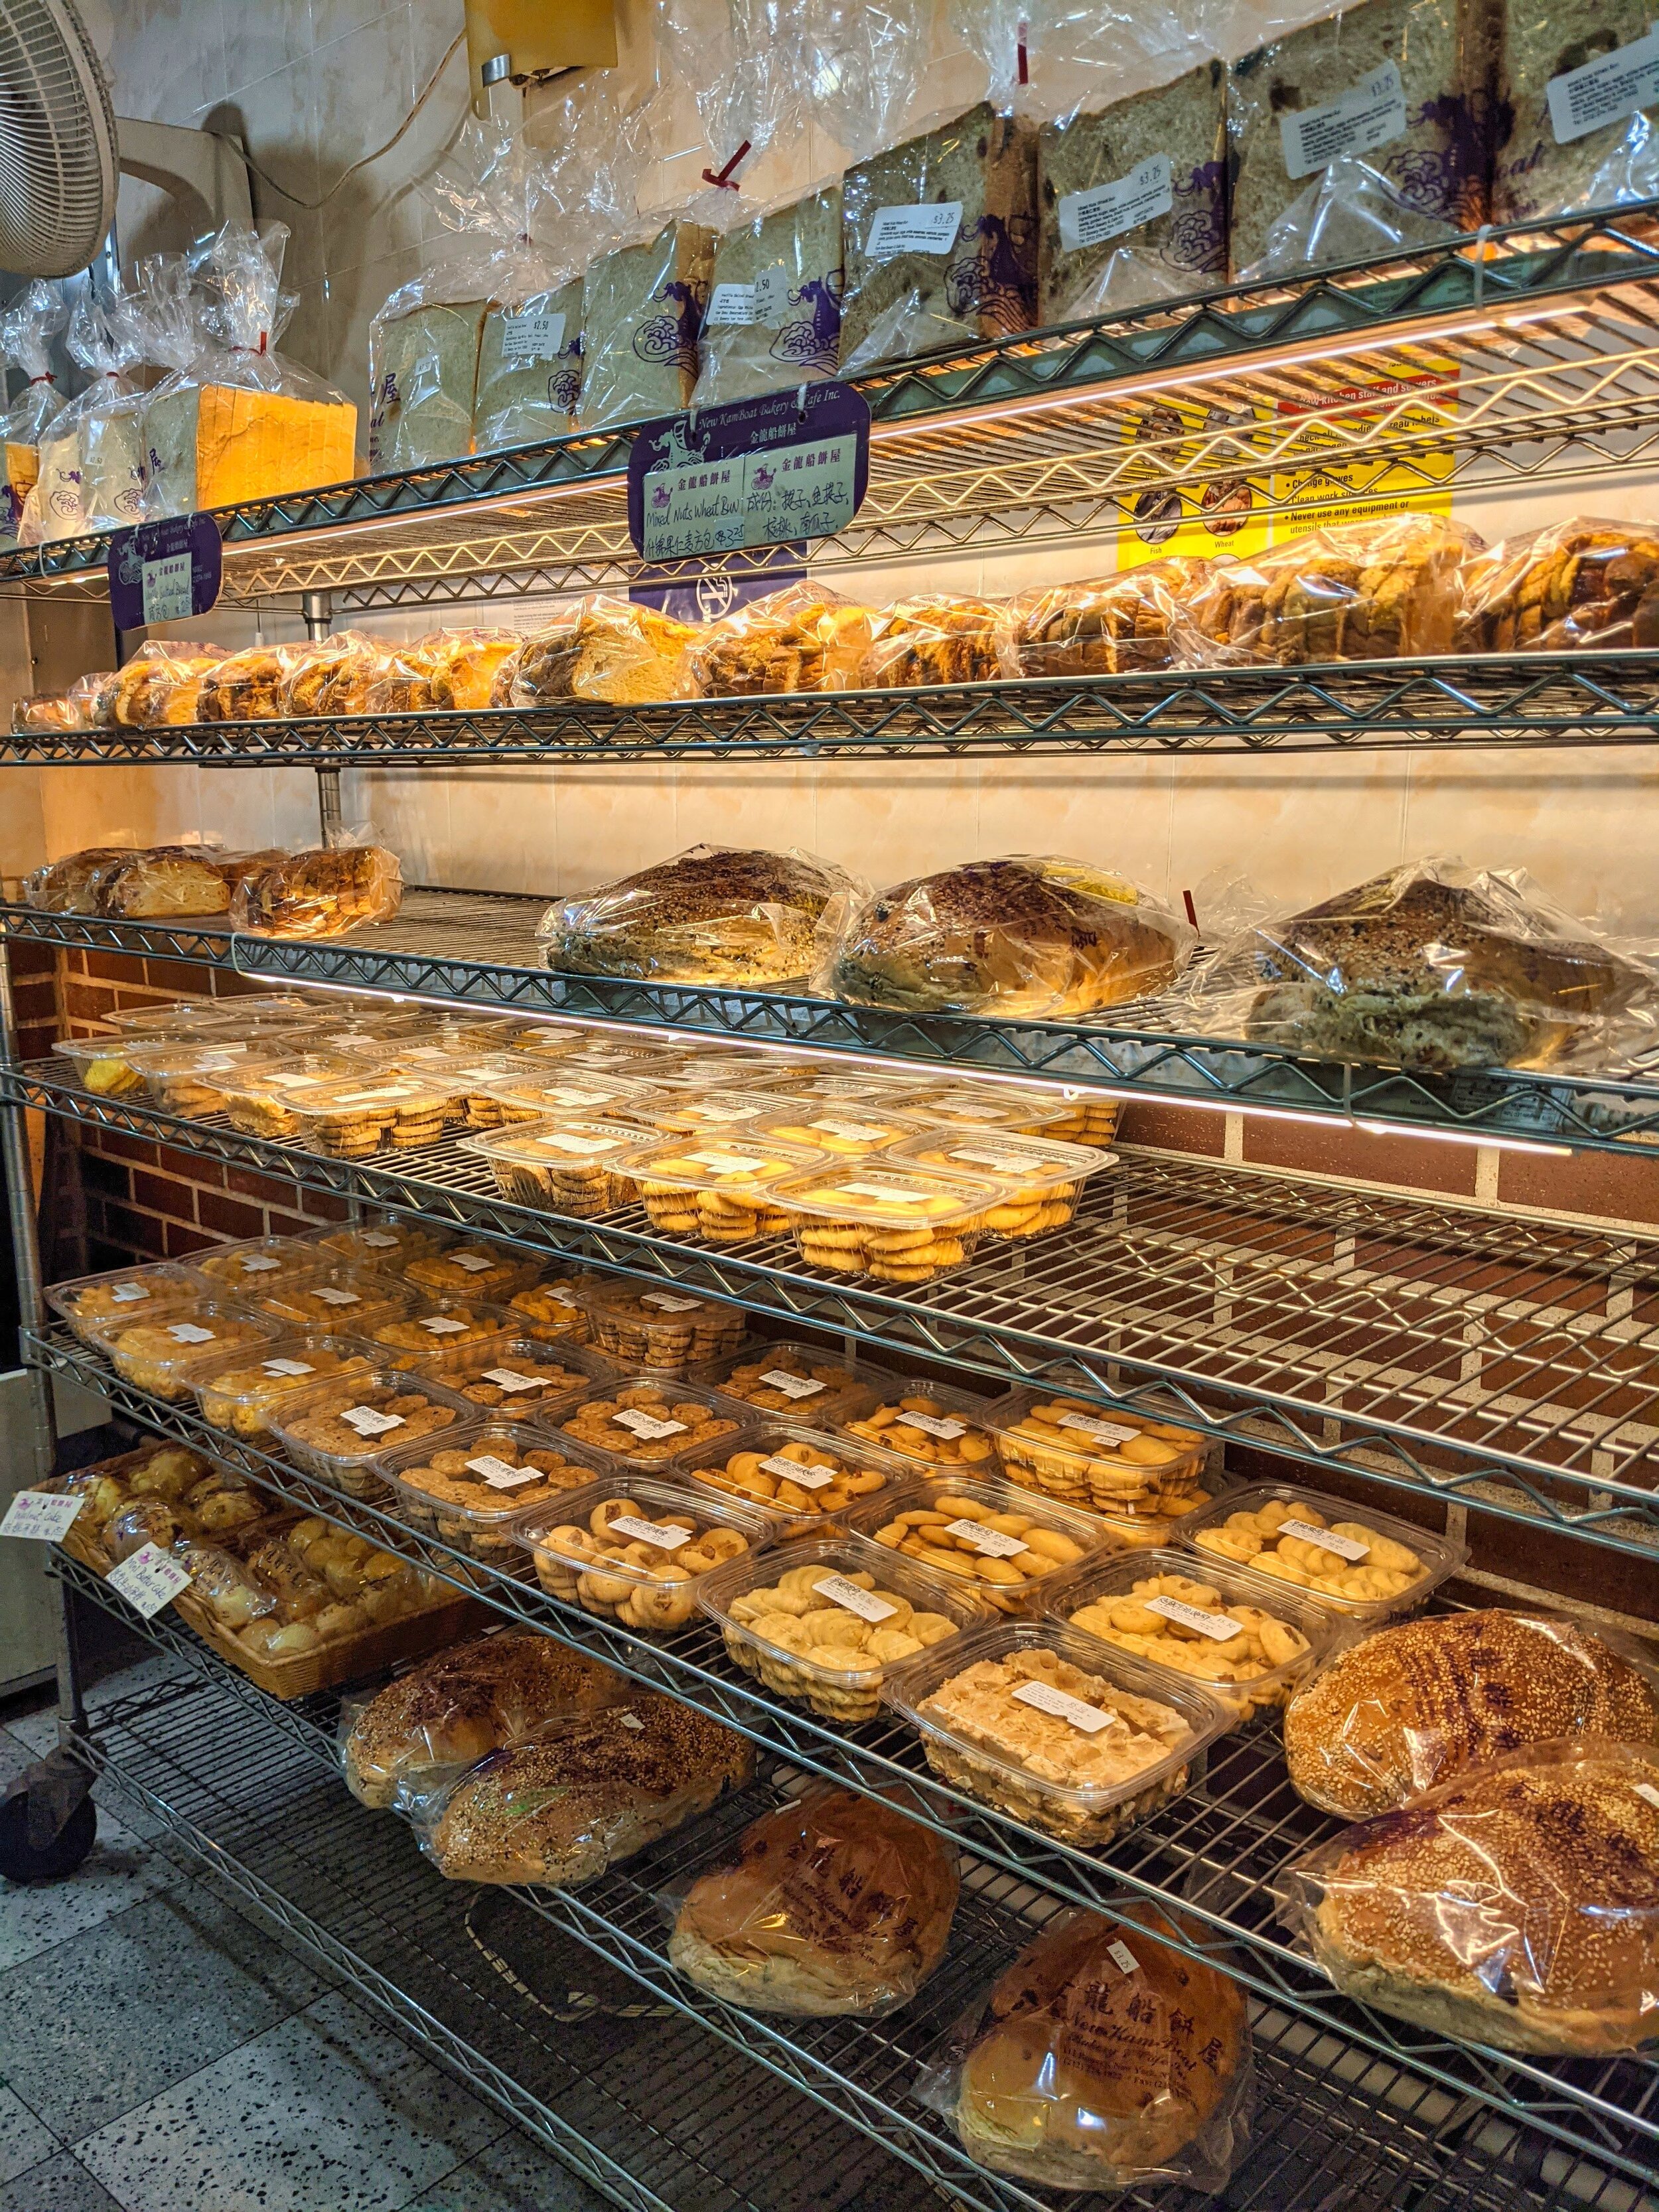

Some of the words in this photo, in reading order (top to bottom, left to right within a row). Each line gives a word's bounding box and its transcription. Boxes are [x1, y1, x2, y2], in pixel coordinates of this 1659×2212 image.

[933, 212, 954, 224] $3.25
[699, 417, 717, 431] New
[759, 400, 789, 416] Bakery
[824, 389, 840, 402] Inc.
[1291, 511, 1315, 522] Never
[1317, 509, 1333, 518] use
[1334, 507, 1350, 516] any
[1352, 500, 1398, 516] equipment
[1289, 522, 1322, 534] utensils
[1214, 540, 1234, 548] Wheat
[151, 1584, 167, 1599] Cake
[1114, 1949, 1131, 1970] $3.25
